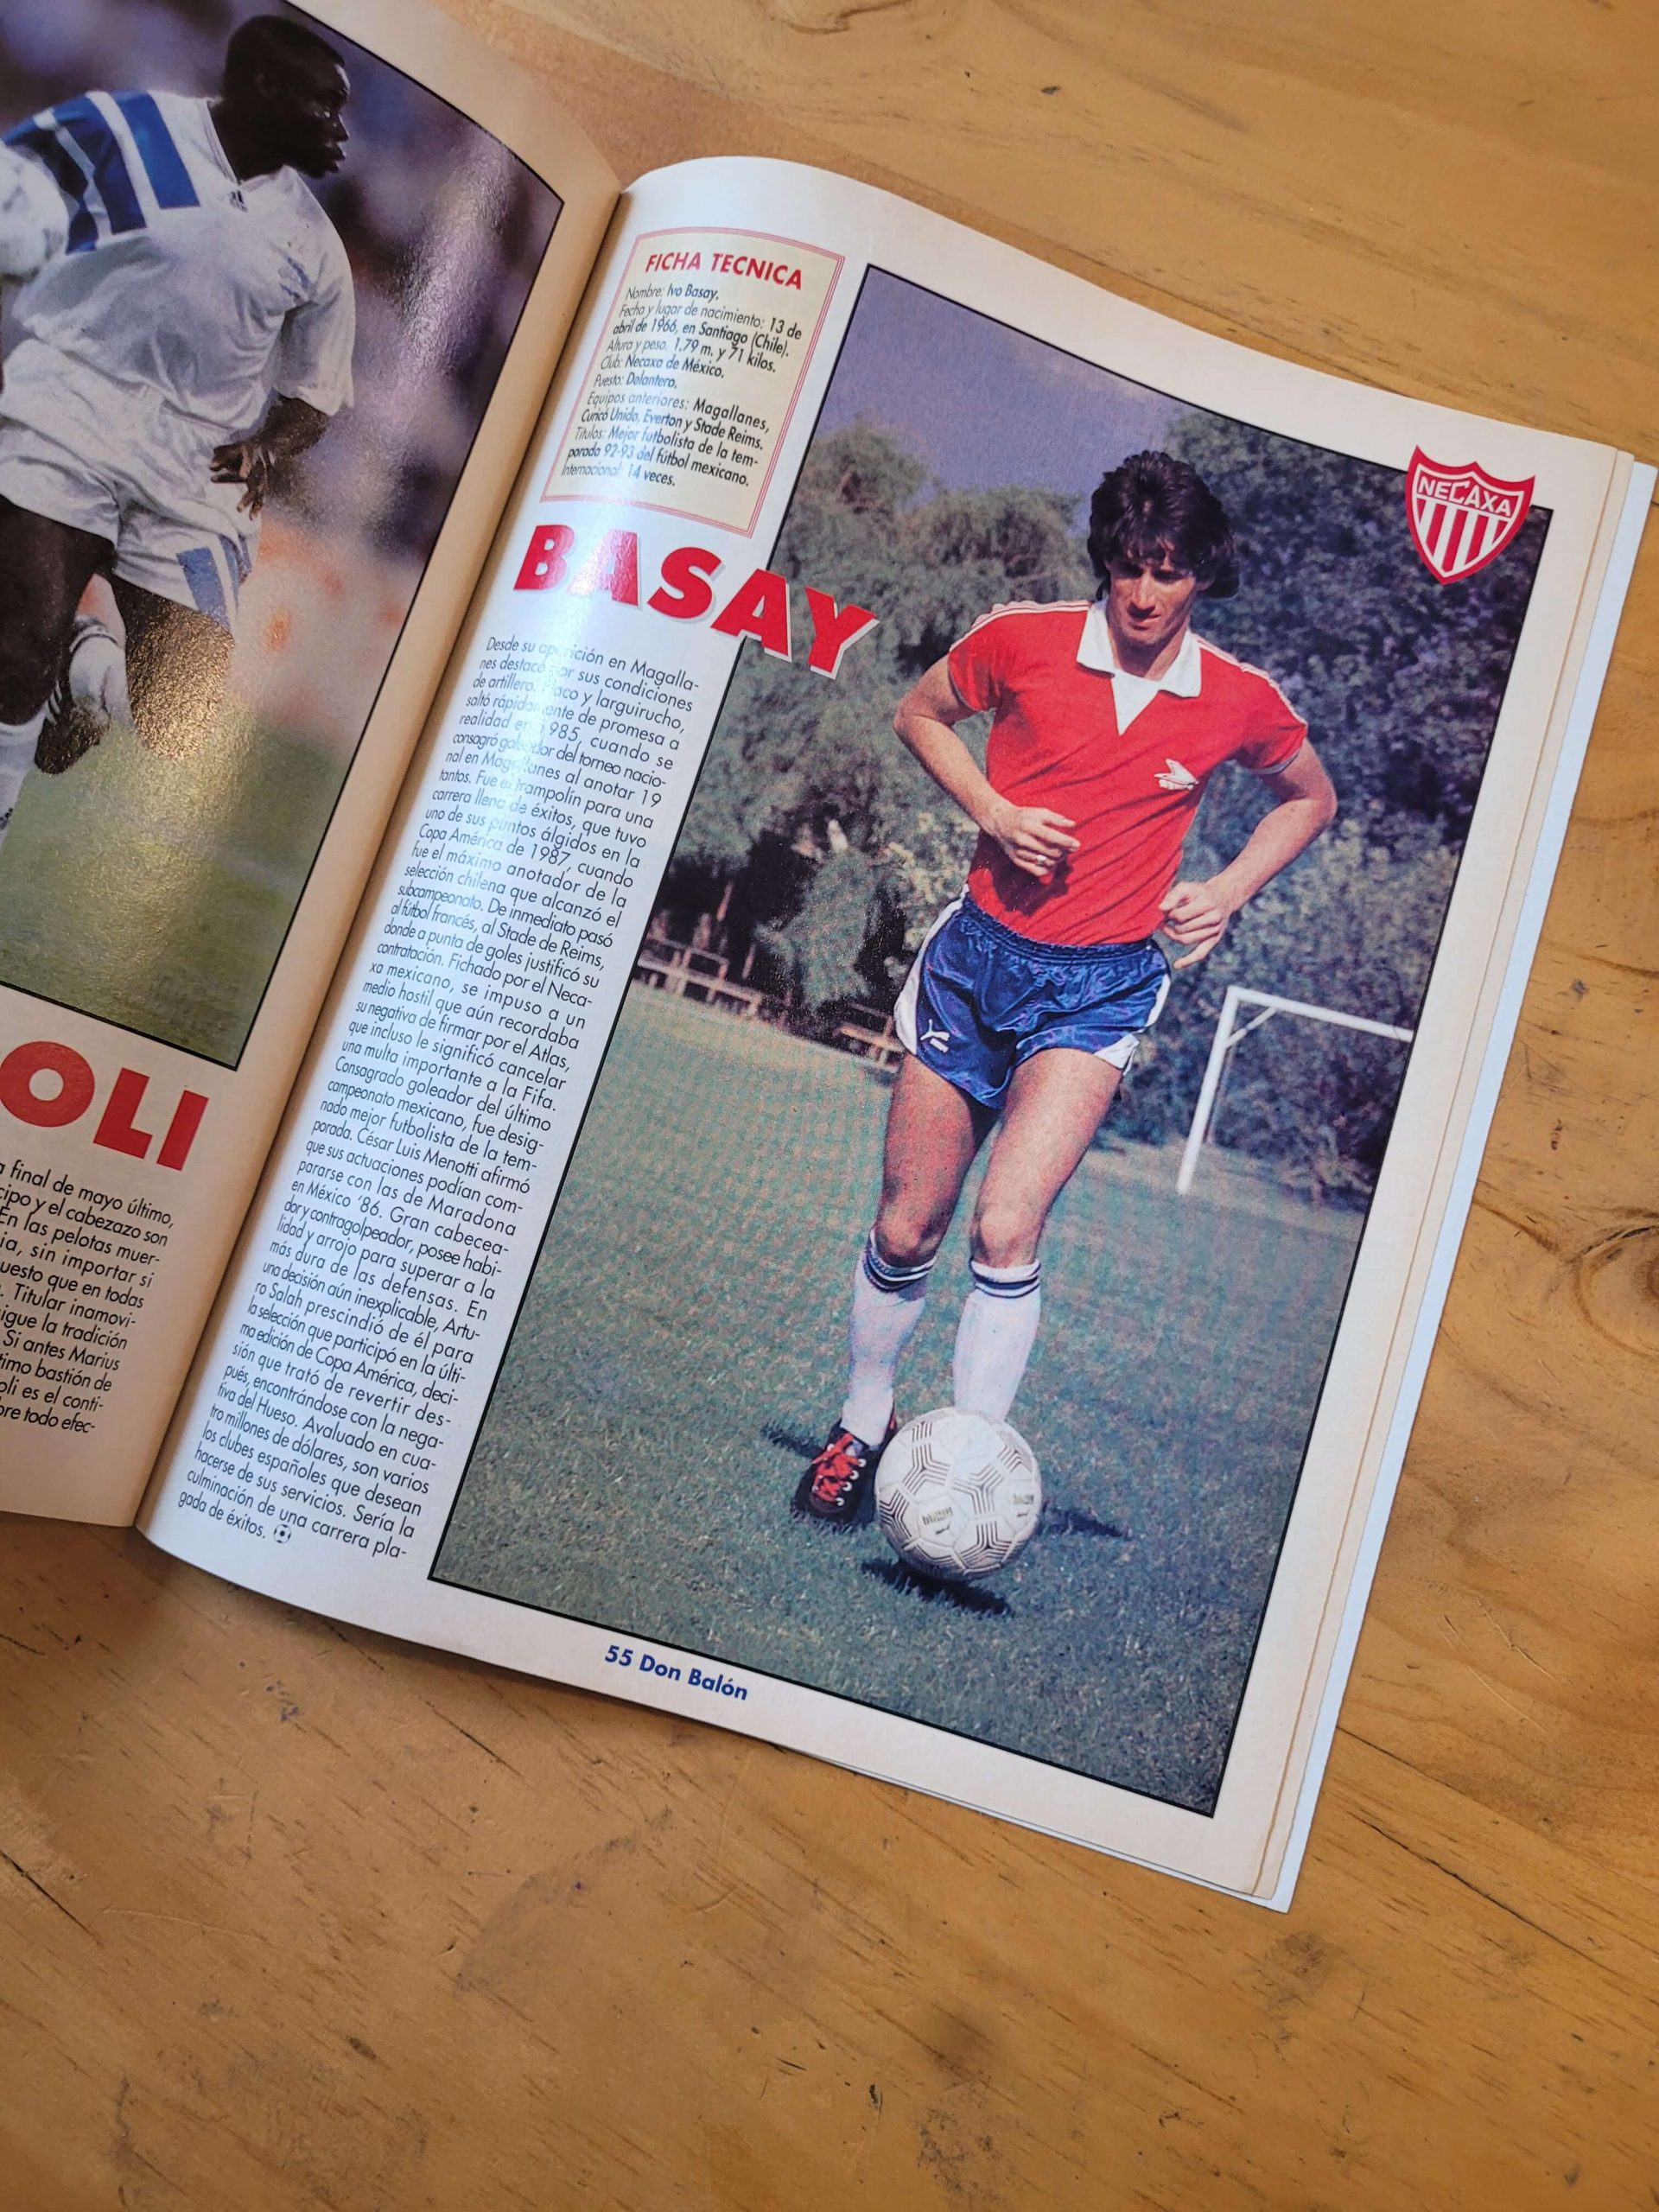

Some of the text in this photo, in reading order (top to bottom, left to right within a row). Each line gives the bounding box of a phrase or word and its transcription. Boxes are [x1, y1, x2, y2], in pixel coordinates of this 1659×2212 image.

[625, 283, 719, 303] Nombre: Ivo Basay.
[645, 251, 802, 291] FICHA TECNICA
[612, 317, 789, 358] abril de 1966, en Santiago (Chile).
[618, 299, 802, 340] Fecha y lugar de nacimiento: 13 de
[600, 352, 724, 378] Club: Necaxa de México.
[605, 336, 633, 353] Altura
[632, 340, 643, 357] y
[674, 337, 700, 353] 1.79
[699, 345, 714, 357] m.
[715, 347, 727, 363] y
[728, 345, 745, 363] 71
[746, 349, 776, 372] kilos.
[593, 370, 677, 389] Puesto: Delantero.
[581, 407, 609, 423] Curicó
[642, 408, 683, 429] Everton
[682, 419, 693, 434] y
[693, 416, 726, 438] Stade
[727, 425, 763, 449] Reims.
[586, 390, 769, 433] Equipos anteriores: Magallanes,
[565, 442, 748, 485] porada 92-93 del fútbol mexicano.
[575, 424, 759, 467] Títulos: Mejor futbolista de la tem-
[644, 470, 675, 486] veces.
[1418, 475, 1511, 517] NECAXA
[513, 524, 878, 677] BASAY
[486, 634, 699, 690] Desde su en Magalla-
[404, 862, 623, 928] selección chilena que alcanzó el
[383, 917, 600, 988] donde a punta de goles justificó su
[354, 1001, 569, 1073] su negativa de firmar por el Atlas,
[334, 1055, 551, 1131] Consagrado goleador del último
[310, 1120, 531, 1194] porada. César Luis Menotti afirmó
[10, 1159, 174, 1229] final de mayo último,
[296, 1160, 516, 1236] pararse con las de Maradona
[0, 1203, 160, 1265] En las pelotas muer-
[29, 1197, 168, 1247] y el cabezazo son
[29, 1242, 155, 1288] sin importar si
[269, 1240, 487, 1321] más dura de las defensas. En
[13, 1282, 136, 1328] Titular inamovi-
[46, 1274, 144, 1308] que en todas
[41, 1312, 128, 1350] la tradición
[254, 1281, 474, 1364] ro Salah prescindió de él para
[2, 1324, 120, 1371] Si antes Marius
[34, 1357, 112, 1392] bastión de
[21, 1384, 104, 1412] es el conti-
[22, 1406, 95, 1433] todo efec-
[201, 1422, 422, 1516] los clubes españoles que desean
[177, 1492, 265, 1538] gada de éxitos.
[605, 1644, 748, 1700] 55 Don Balón
